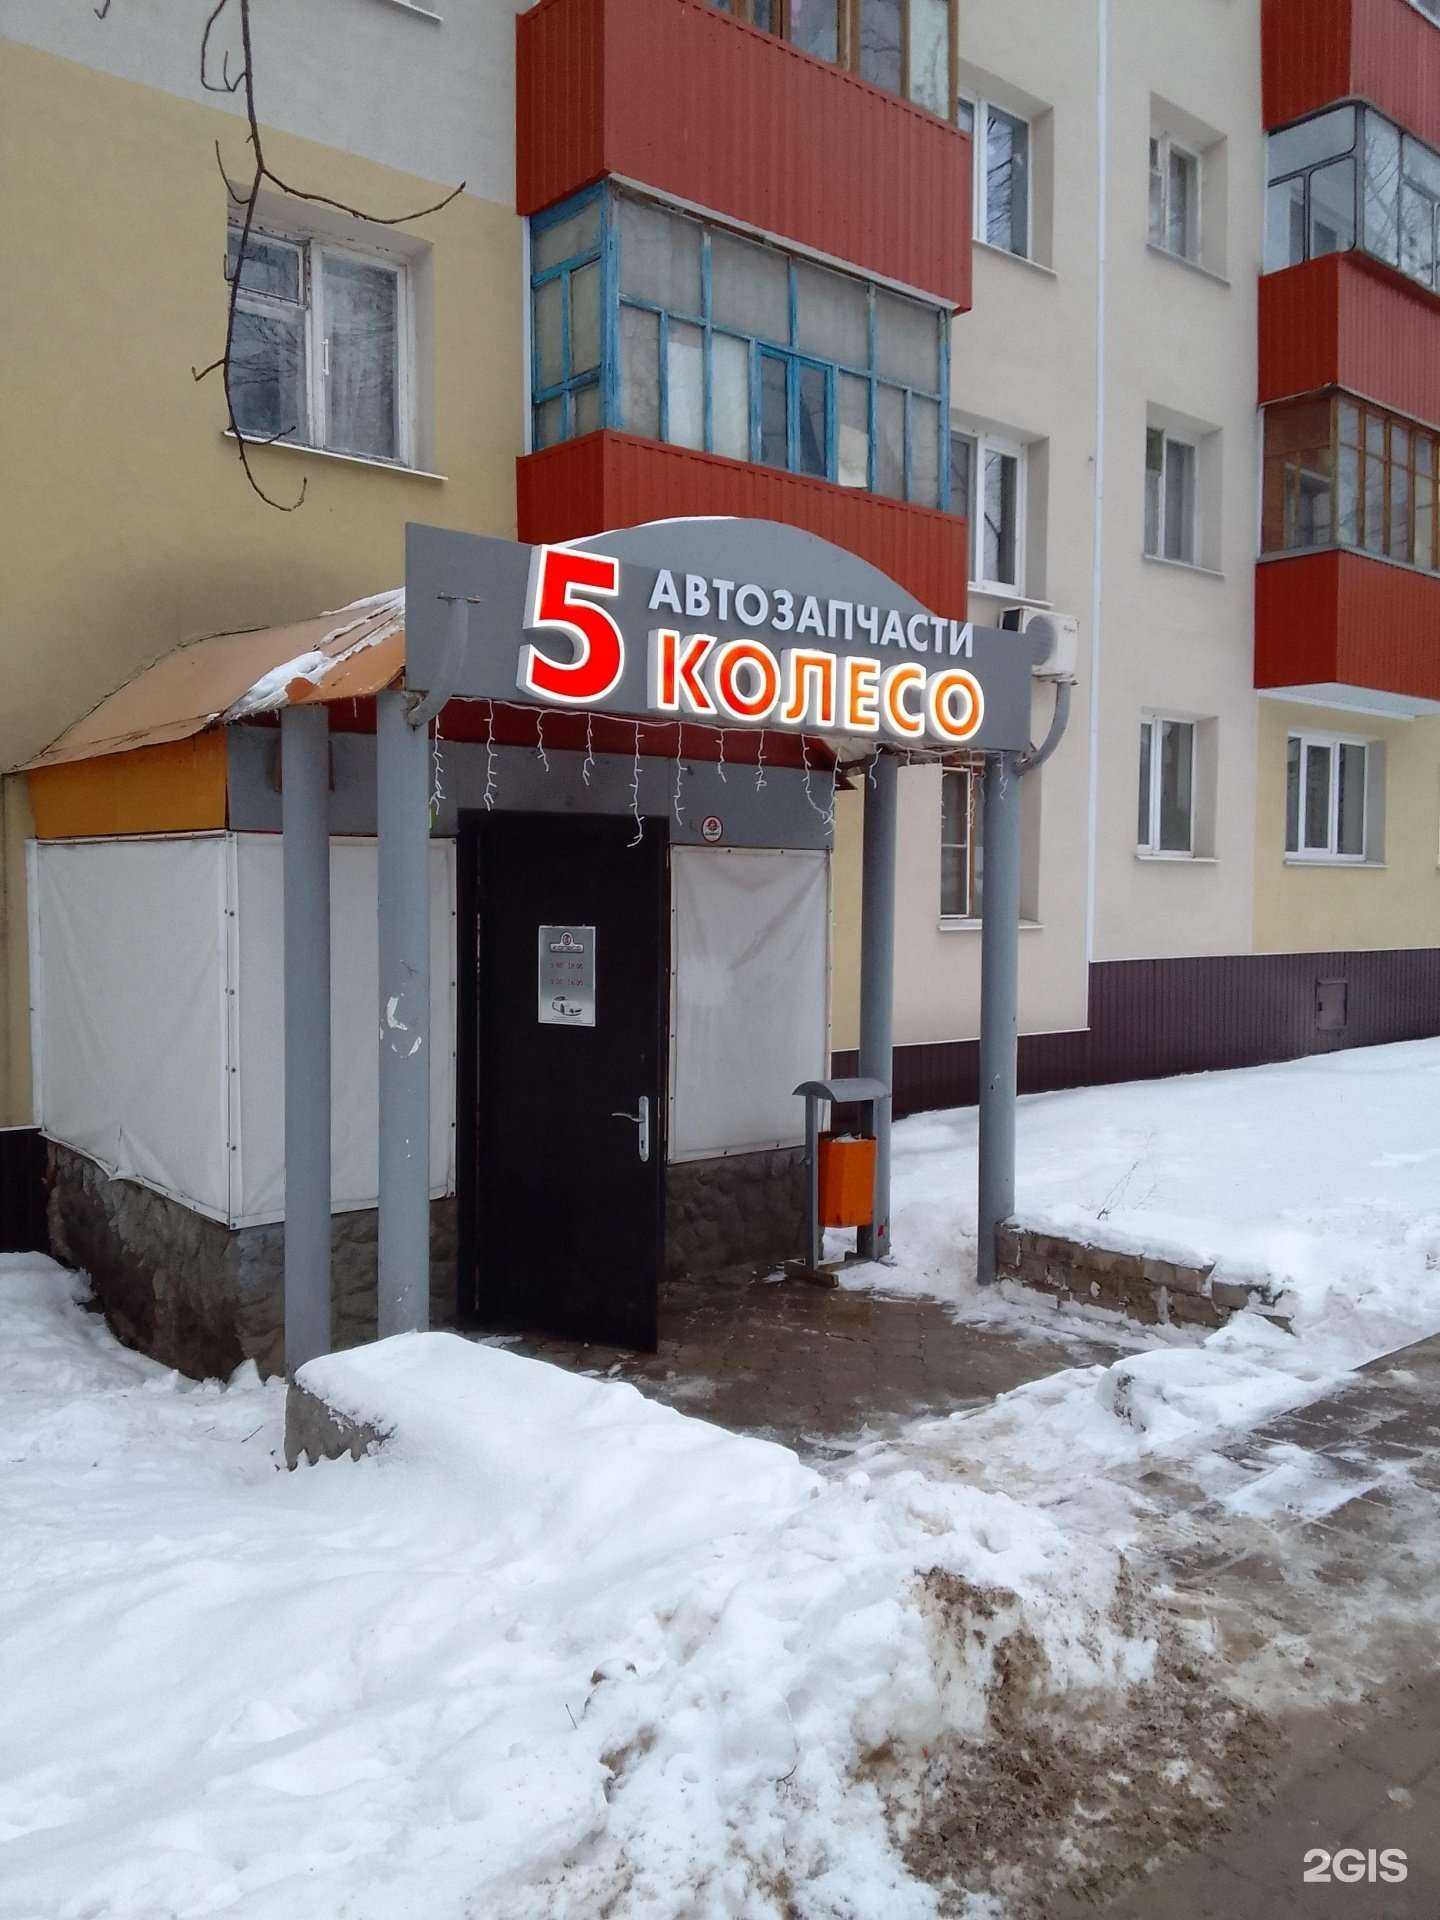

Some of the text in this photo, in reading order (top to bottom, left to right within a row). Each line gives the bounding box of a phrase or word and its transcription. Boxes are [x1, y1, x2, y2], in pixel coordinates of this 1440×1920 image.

[519, 543, 985, 742] 5 КОЛЕСО
[649, 568, 975, 657] АВТОЗАПЧАСТИ
